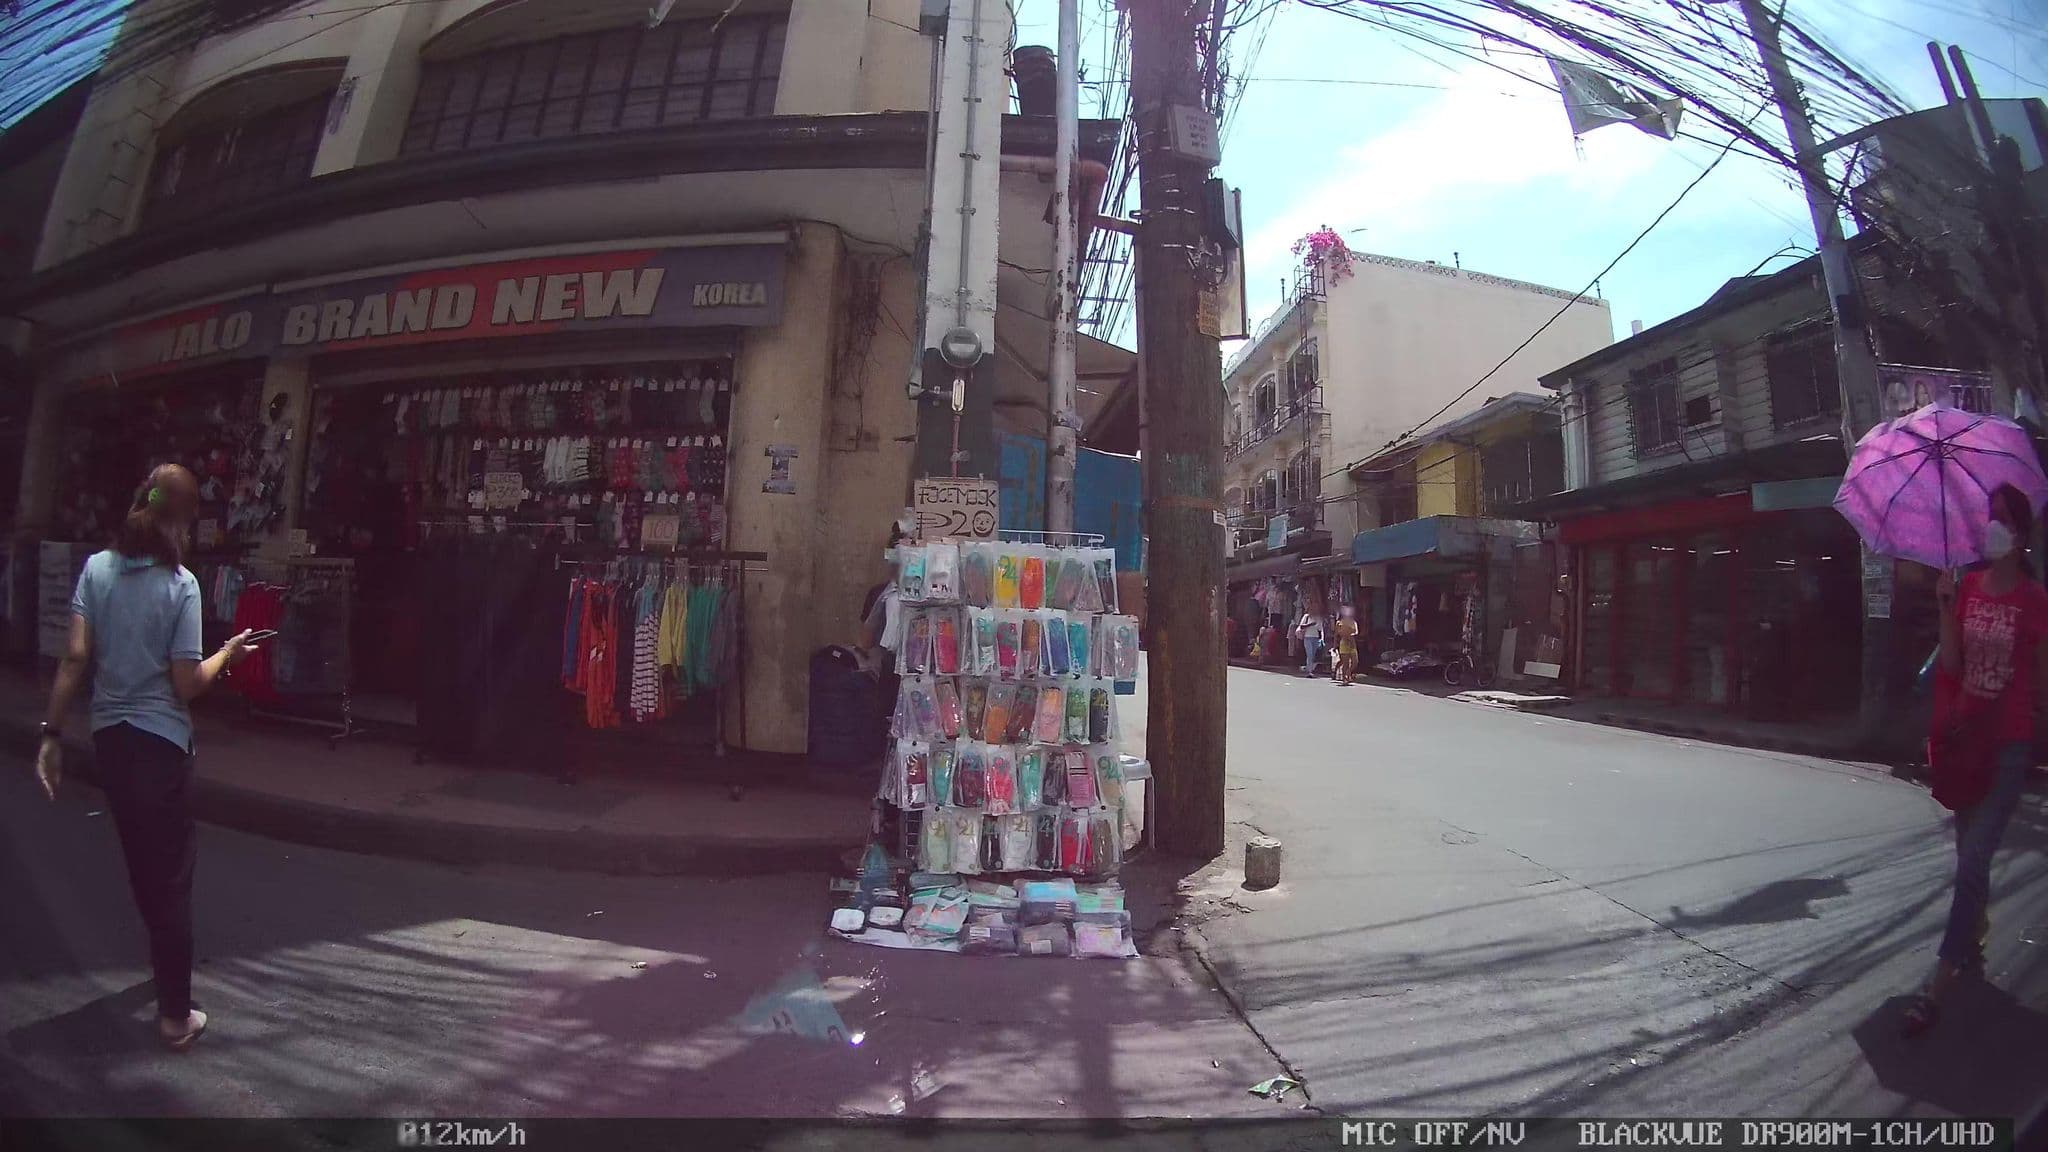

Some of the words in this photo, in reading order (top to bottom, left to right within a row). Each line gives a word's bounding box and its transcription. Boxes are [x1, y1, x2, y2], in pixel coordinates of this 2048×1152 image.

[281, 283, 478, 346] BRAND
[491, 267, 665, 326] NEW
[692, 282, 768, 308] KOREA
